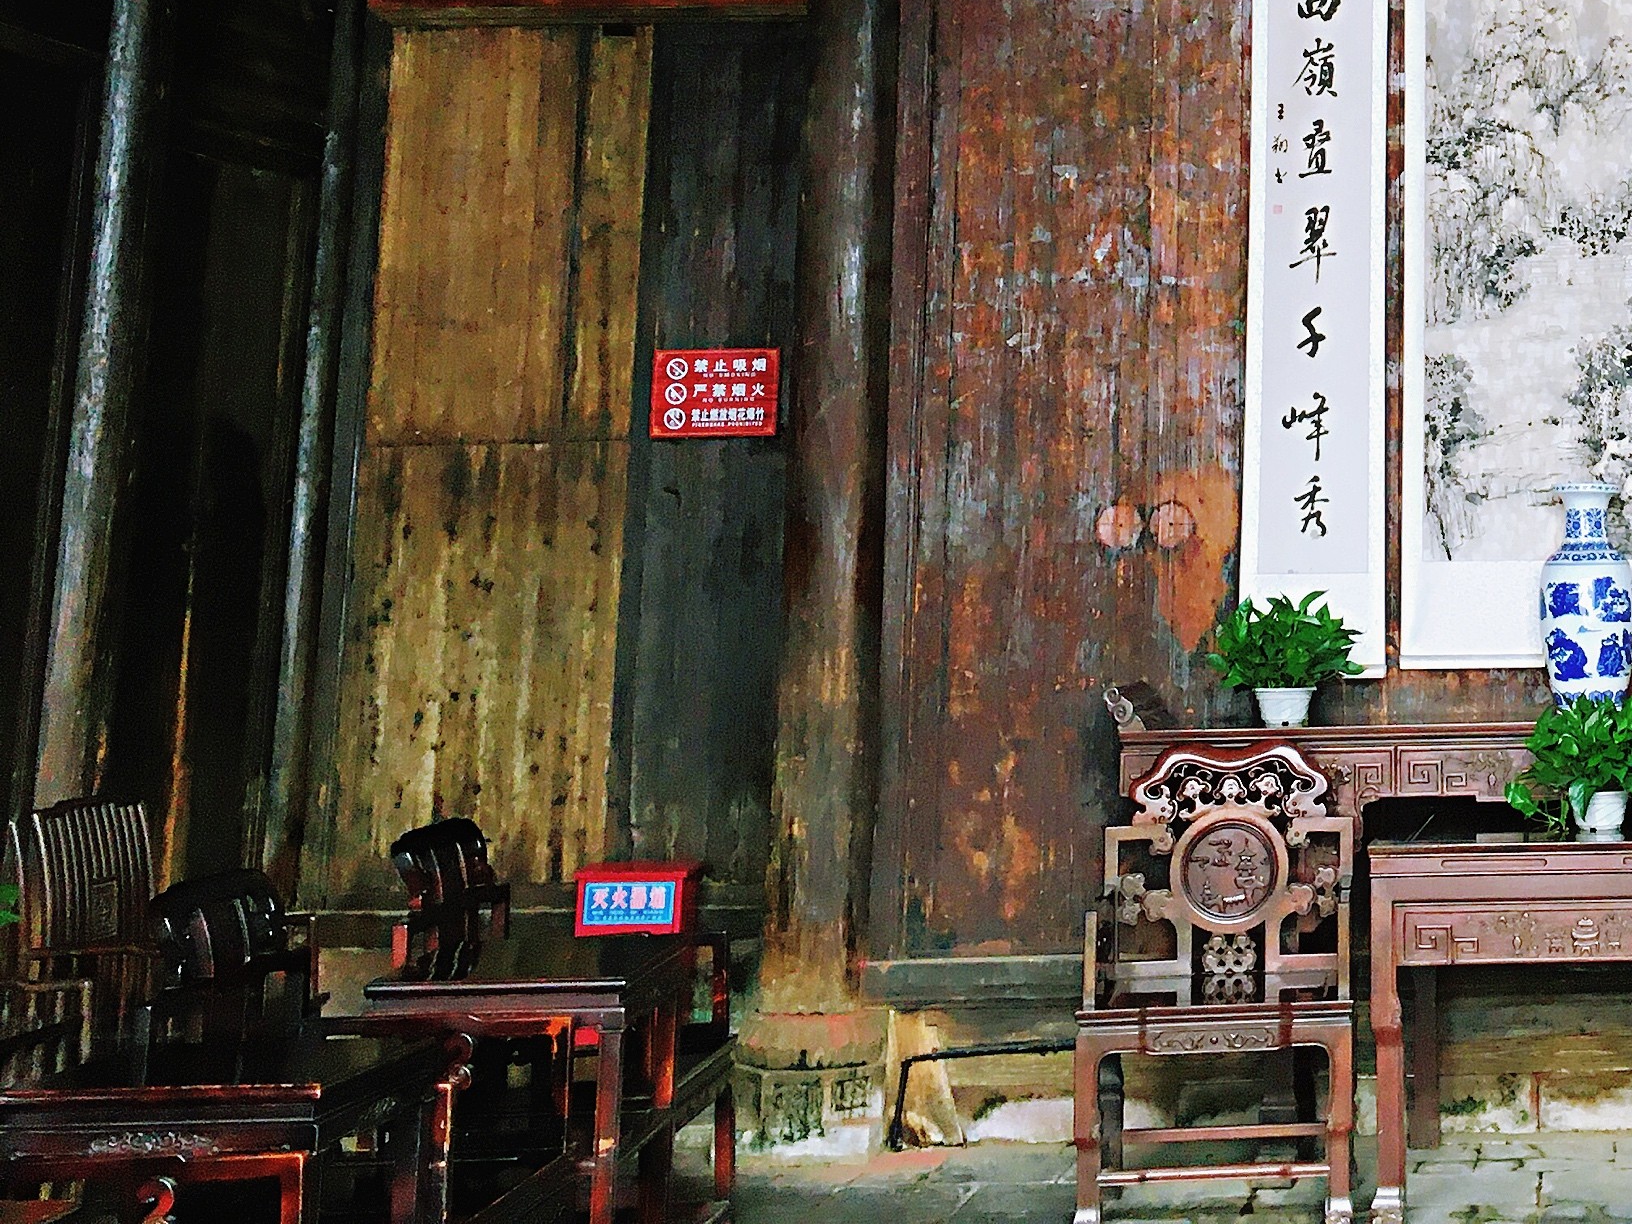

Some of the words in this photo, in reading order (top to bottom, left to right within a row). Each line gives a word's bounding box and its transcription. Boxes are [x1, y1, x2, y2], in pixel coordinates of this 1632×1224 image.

[694, 358, 767, 373] 禁止吸烟
[692, 383, 765, 398] 严禁烟火
